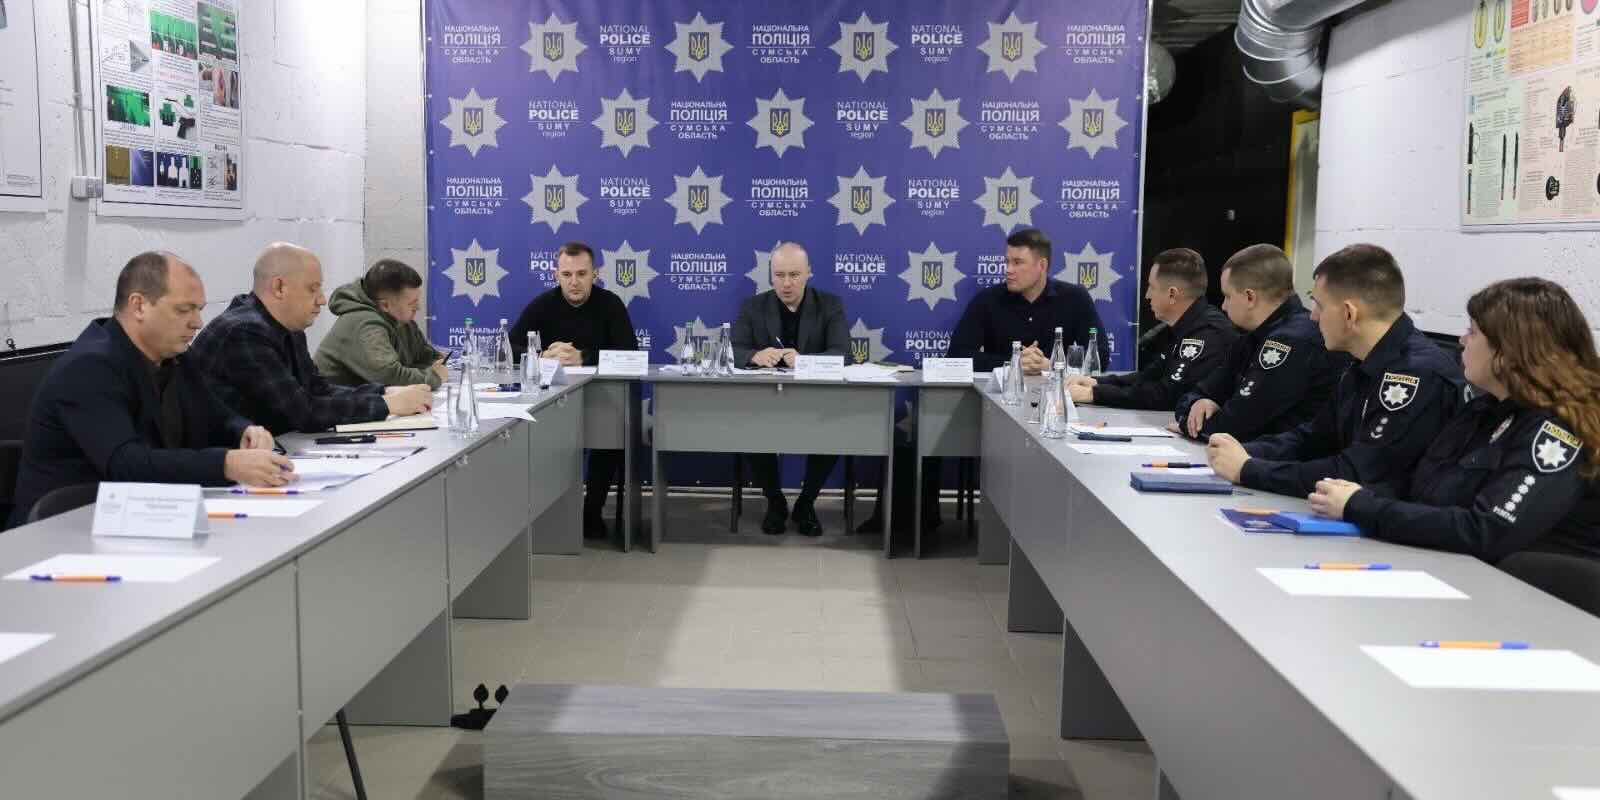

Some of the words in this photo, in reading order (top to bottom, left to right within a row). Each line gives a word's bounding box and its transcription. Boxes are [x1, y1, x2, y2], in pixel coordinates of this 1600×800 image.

[444, 25, 500, 33] НАЦІОНАЛЬНА
[600, 25, 650, 34] NATIONAL
[912, 25, 961, 33] NATIONAL
[444, 33, 500, 46] ПОЛІЦІЯ
[600, 34, 650, 44] POLICE
[752, 33, 810, 46] ПОЛІЦІЯ
[912, 34, 962, 44] POLICE
[1067, 33, 1125, 46] ПОЛІЦІЯ
[920, 47, 952, 55] SUMY
[1066, 48, 1123, 56] СУМСЬКА
[452, 56, 491, 64] ОБЛАСТЬ
[837, 102, 888, 110] NATIONAL
[529, 110, 578, 120] POLICE
[671, 110, 727, 122] ПОЛІЦІЯ
[837, 111, 888, 120] POLICE
[982, 110, 1039, 123] ПОЛІЦІЯ
[538, 123, 570, 131] SUMY
[447, 177, 502, 185] НАЦІОНАЛЬНА
[601, 178, 651, 186] NATIONAL
[909, 179, 959, 187] NATIONAL
[446, 186, 502, 198] ПОЛІЦІЯ
[601, 186, 650, 197] POLICE
[752, 187, 808, 199] ПОЛІЦІЯ
[908, 188, 959, 198] POLICE
[1062, 188, 1120, 200] ПОЛІЦІЯ
[918, 201, 949, 209] SUMY
[530, 251, 560, 260] NATIO
[835, 254, 885, 262] NATIONAL
[530, 260, 557, 270] POL
[671, 261, 726, 273] ПОЛІЦІЯ
[835, 263, 885, 272] POLICE
[844, 276, 876, 284] SUMY
